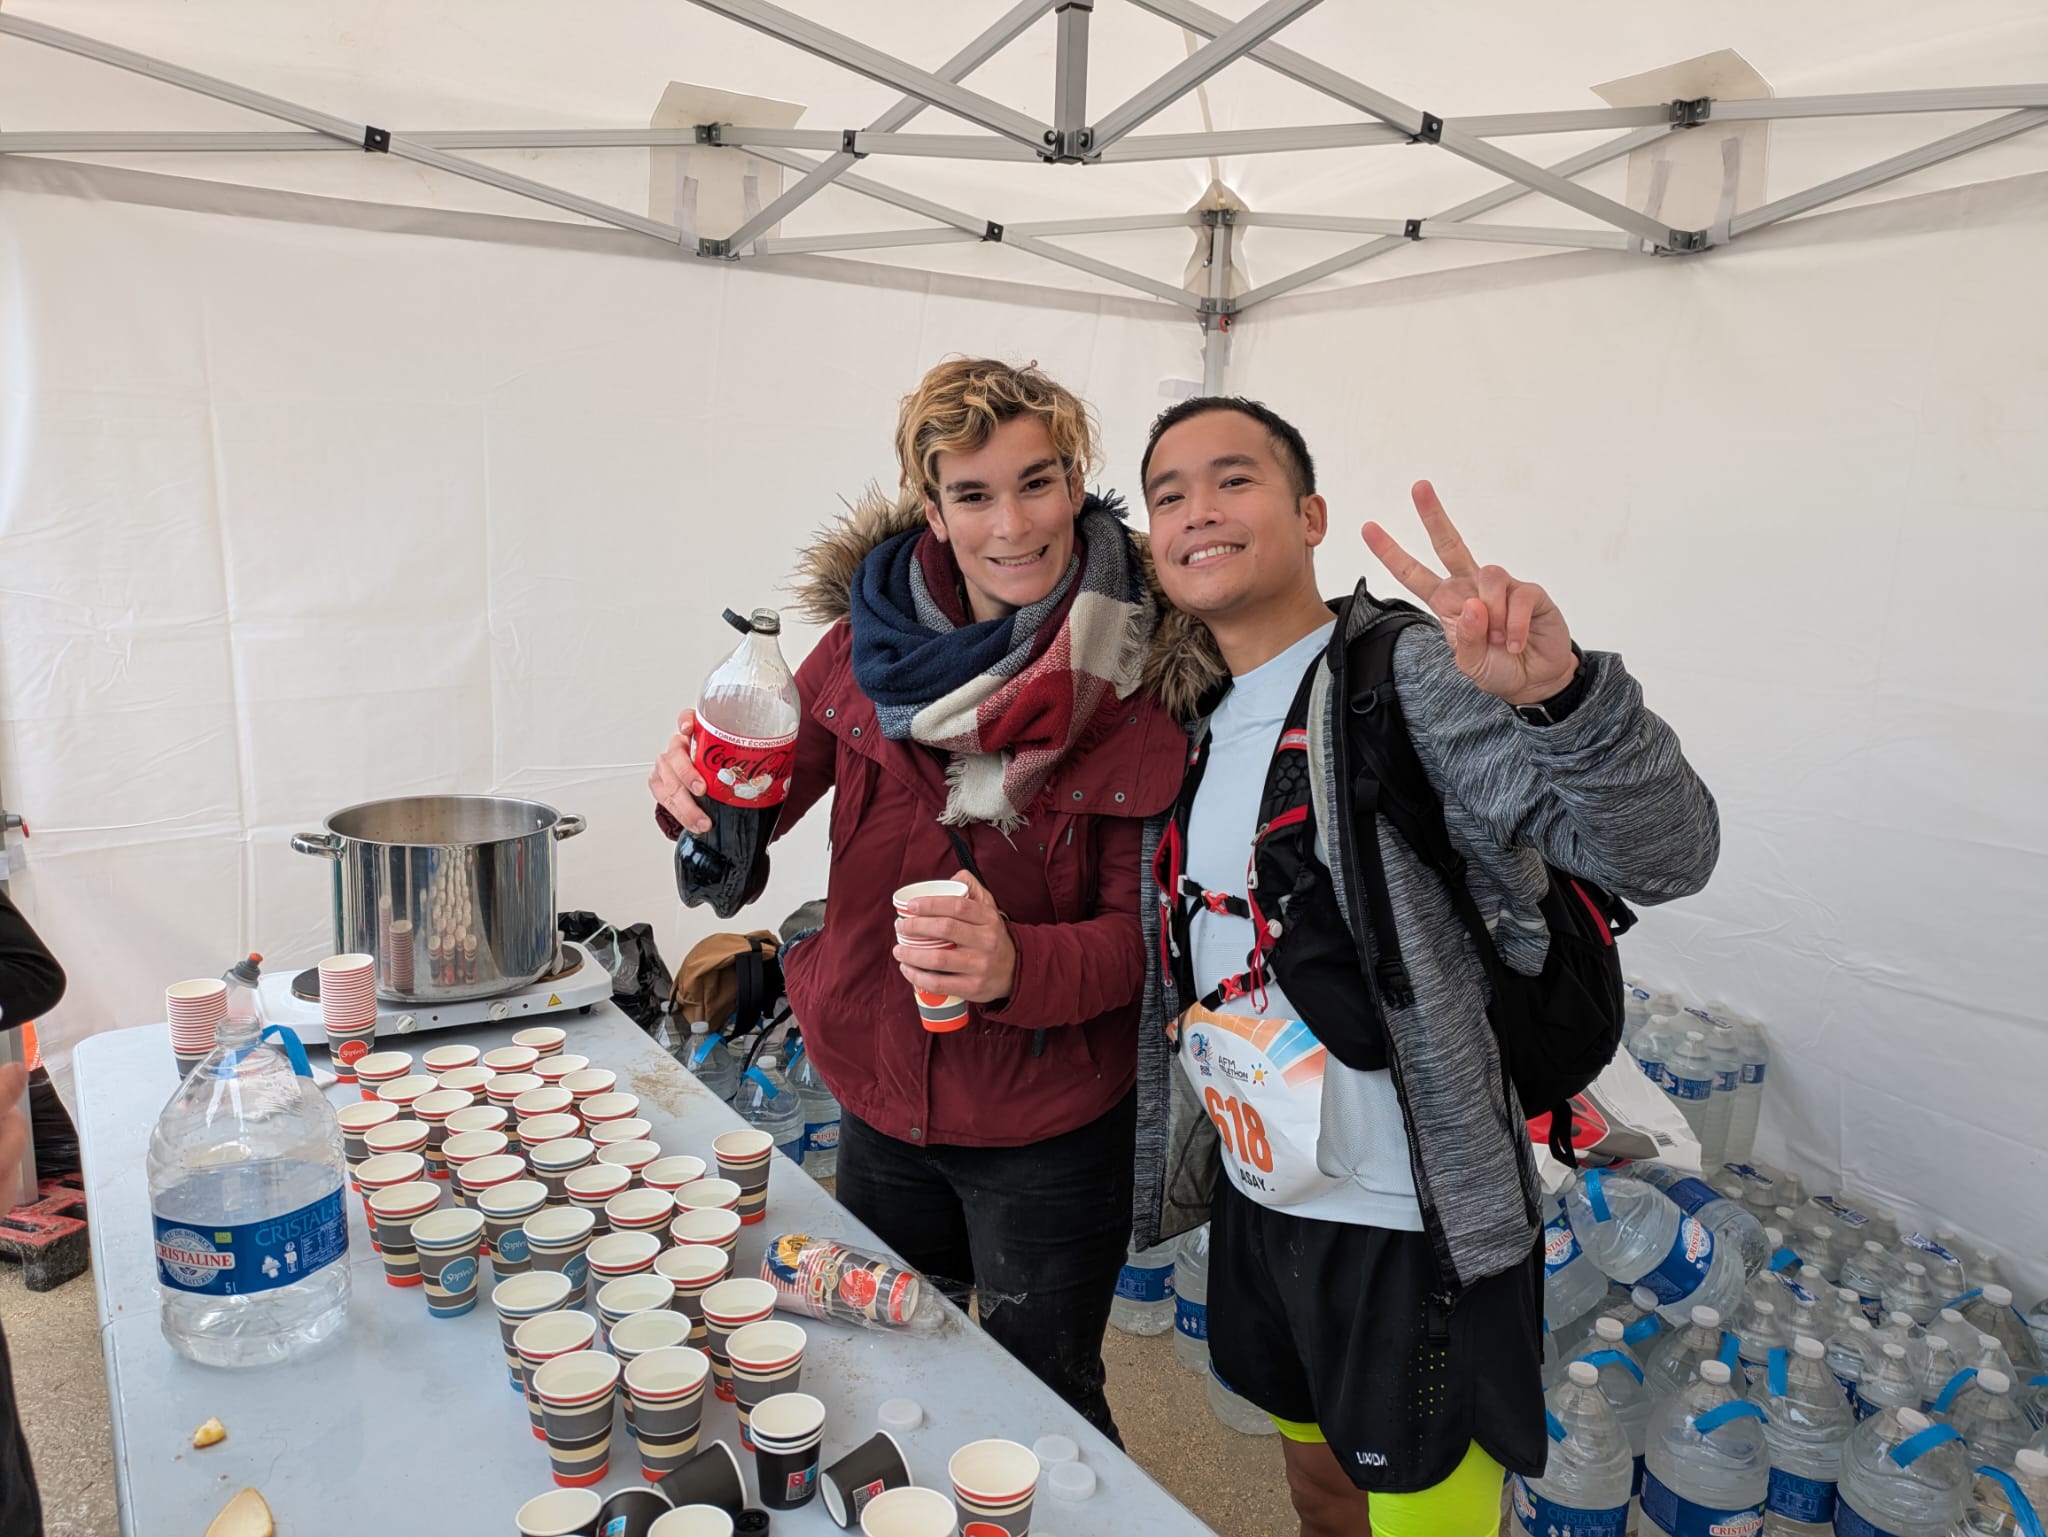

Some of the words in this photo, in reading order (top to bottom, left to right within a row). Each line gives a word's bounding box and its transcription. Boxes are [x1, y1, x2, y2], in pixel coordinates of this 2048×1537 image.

[714, 729, 746, 745] FORMAT
[1204, 1086, 1274, 1174] 618
[157, 1243, 233, 1268] CRISTALINE
